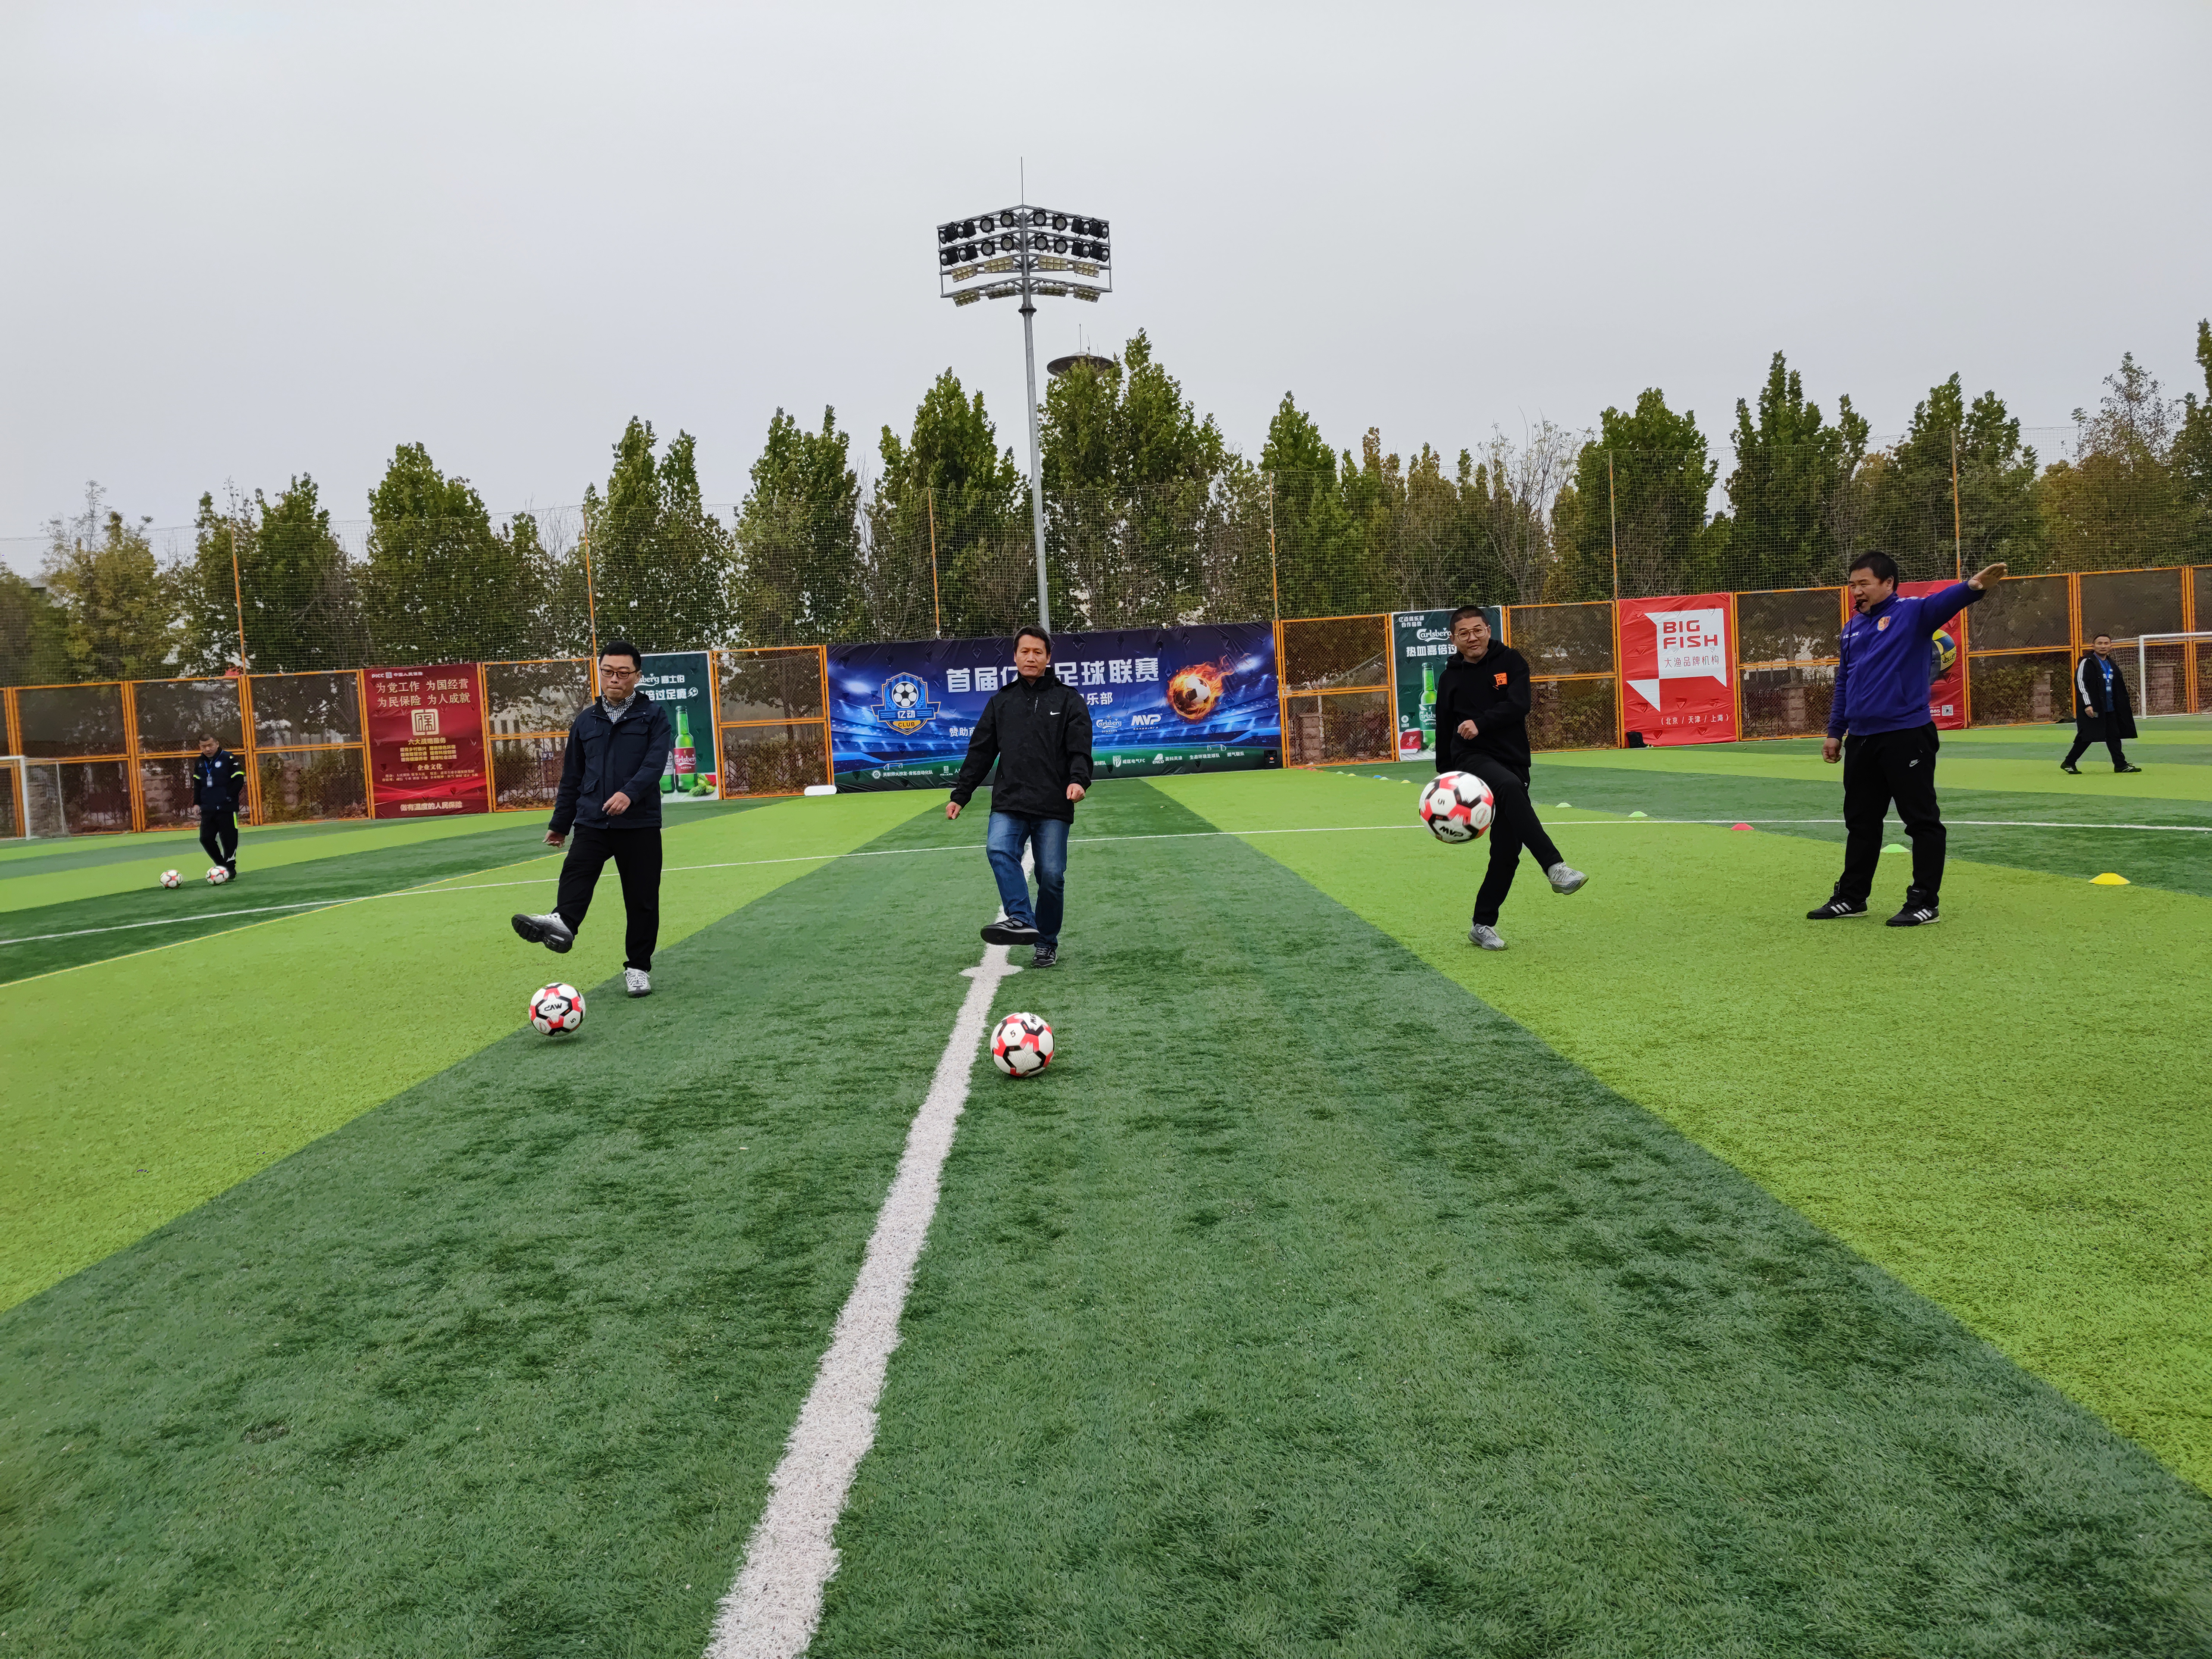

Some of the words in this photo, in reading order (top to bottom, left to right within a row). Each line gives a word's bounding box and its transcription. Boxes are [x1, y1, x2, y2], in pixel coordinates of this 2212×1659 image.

[1663, 620, 1700, 634] BIG
[1663, 634, 1718, 649] FISH
[1664, 655, 1719, 668] 大渔品牌机构
[661, 675, 685, 684] 嘉士伯
[946, 658, 1159, 693] 首届亿足球联赛
[376, 681, 420, 694] 为党工作
[426, 678, 468, 691] 为国经营
[377, 695, 421, 708] 为民保险
[427, 692, 471, 706] 为人成就
[640, 688, 687, 701] 倍过足瘾
[1080, 692, 1113, 706] 乐部
[898, 710, 915, 718] 亿动
[1131, 714, 1161, 726] MVP
[1096, 718, 1122, 729] Carlsberg
[400, 801, 463, 811] 做有温度的人民保险
[1438, 798, 1445, 806] 5
[1439, 826, 1464, 838] MVP
[544, 1003, 563, 1011] MVP
